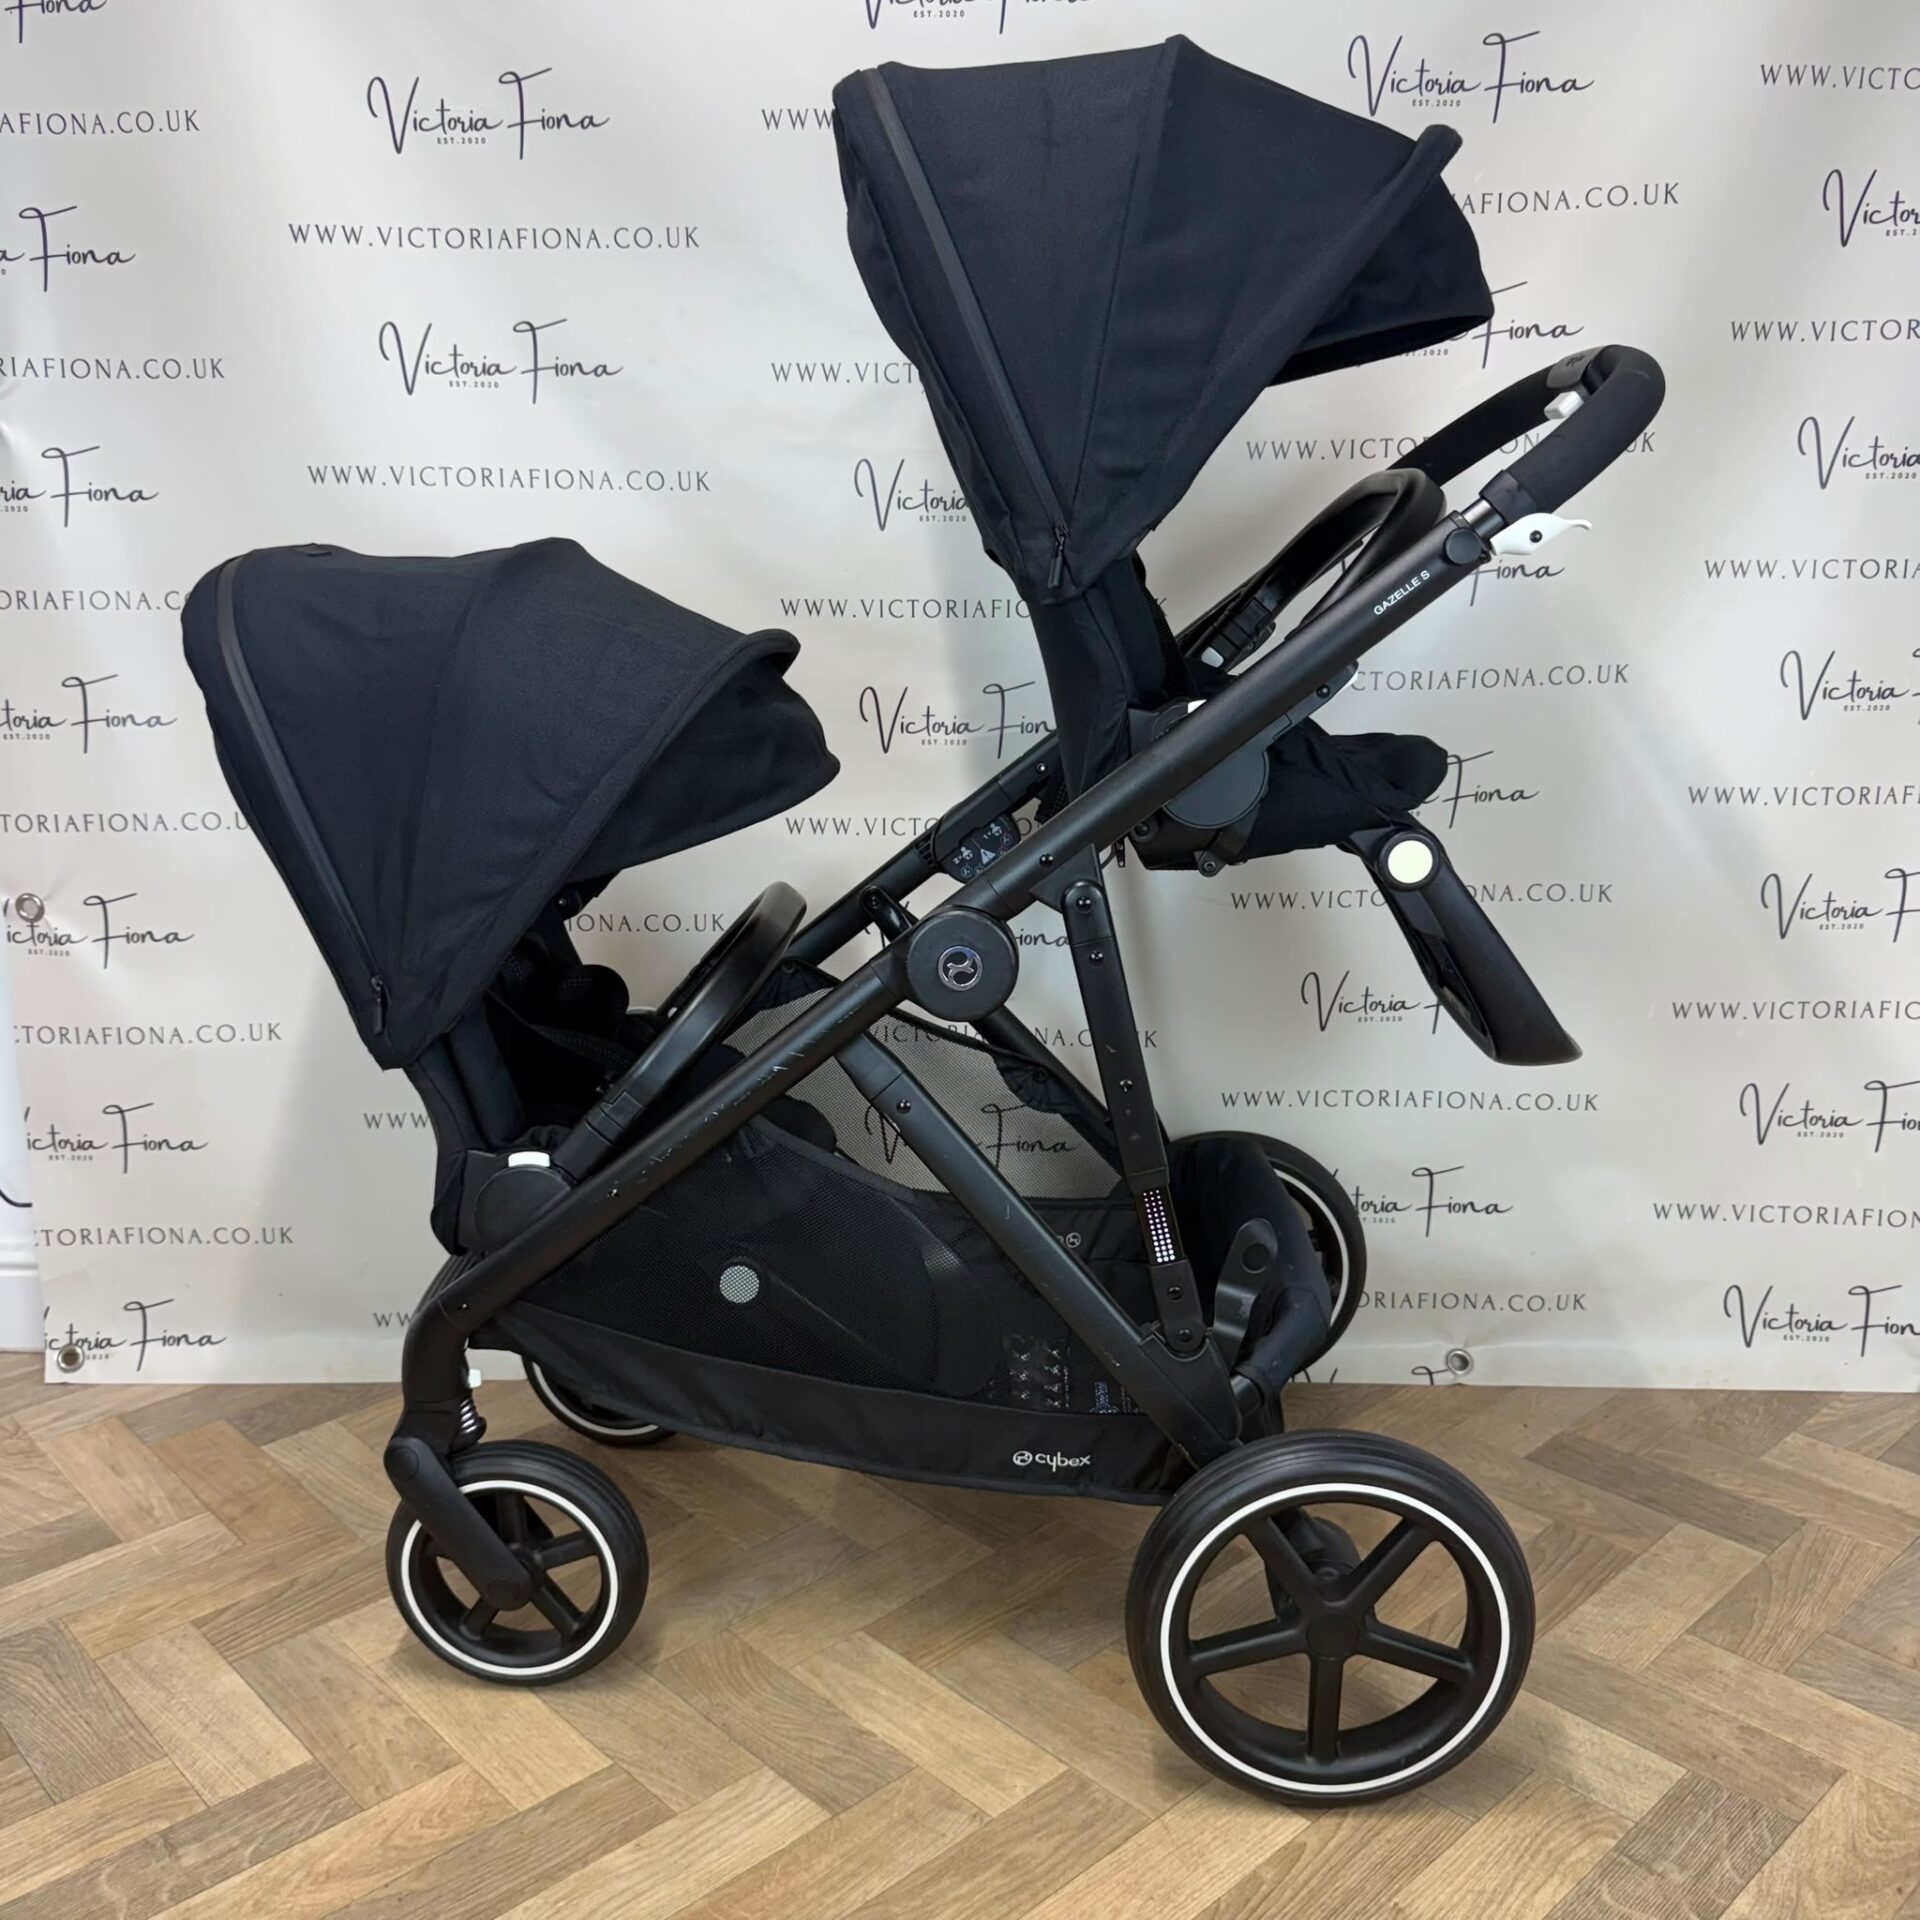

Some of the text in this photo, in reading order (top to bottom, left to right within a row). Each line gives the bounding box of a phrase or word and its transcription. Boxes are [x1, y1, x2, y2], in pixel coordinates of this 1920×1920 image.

[913, 10, 965, 18] EST.2020
[1348, 30, 1595, 124] Victoria Fiona
[367, 67, 610, 160] Victoria Fiona
[436, 137, 487, 145] EST.2020
[1451, 183, 1680, 215] AFIONA.CO.UK
[19, 205, 136, 292] Fiona
[288, 223, 700, 250] WWW.VICTORIAFIONA.CO.UK
[379, 318, 624, 404] Victoria Fiona
[41, 446, 159, 528] Fiona
[307, 466, 711, 492] WWW.VICTORIAFIONA.CO.UK
[1373, 569, 1430, 615] GAZELLE S
[61, 674, 178, 754] Fiona
[1780, 650, 1911, 721] Victoria
[859, 686, 984, 754] Victoria
[83, 893, 195, 969] Fiona
[1760, 873, 1884, 939] Victoria
[1301, 970, 1421, 1032] Victoria
[14, 1022, 283, 1046] TORIAFIONA.CO.UK
[1221, 1089, 1599, 1111] WWW.VICTORIAFIONA.CO.UK
[1740, 1082, 1864, 1145] Victoria
[102, 1102, 209, 1174] Fiona
[1411, 1166, 1514, 1238] Fiona
[34, 1226, 294, 1247] TORIAFIONA.CO.UK
[122, 1298, 228, 1373] Fiona
[1723, 1284, 1848, 1348] Victoria
[1035, 1451, 1091, 1473] cybex
